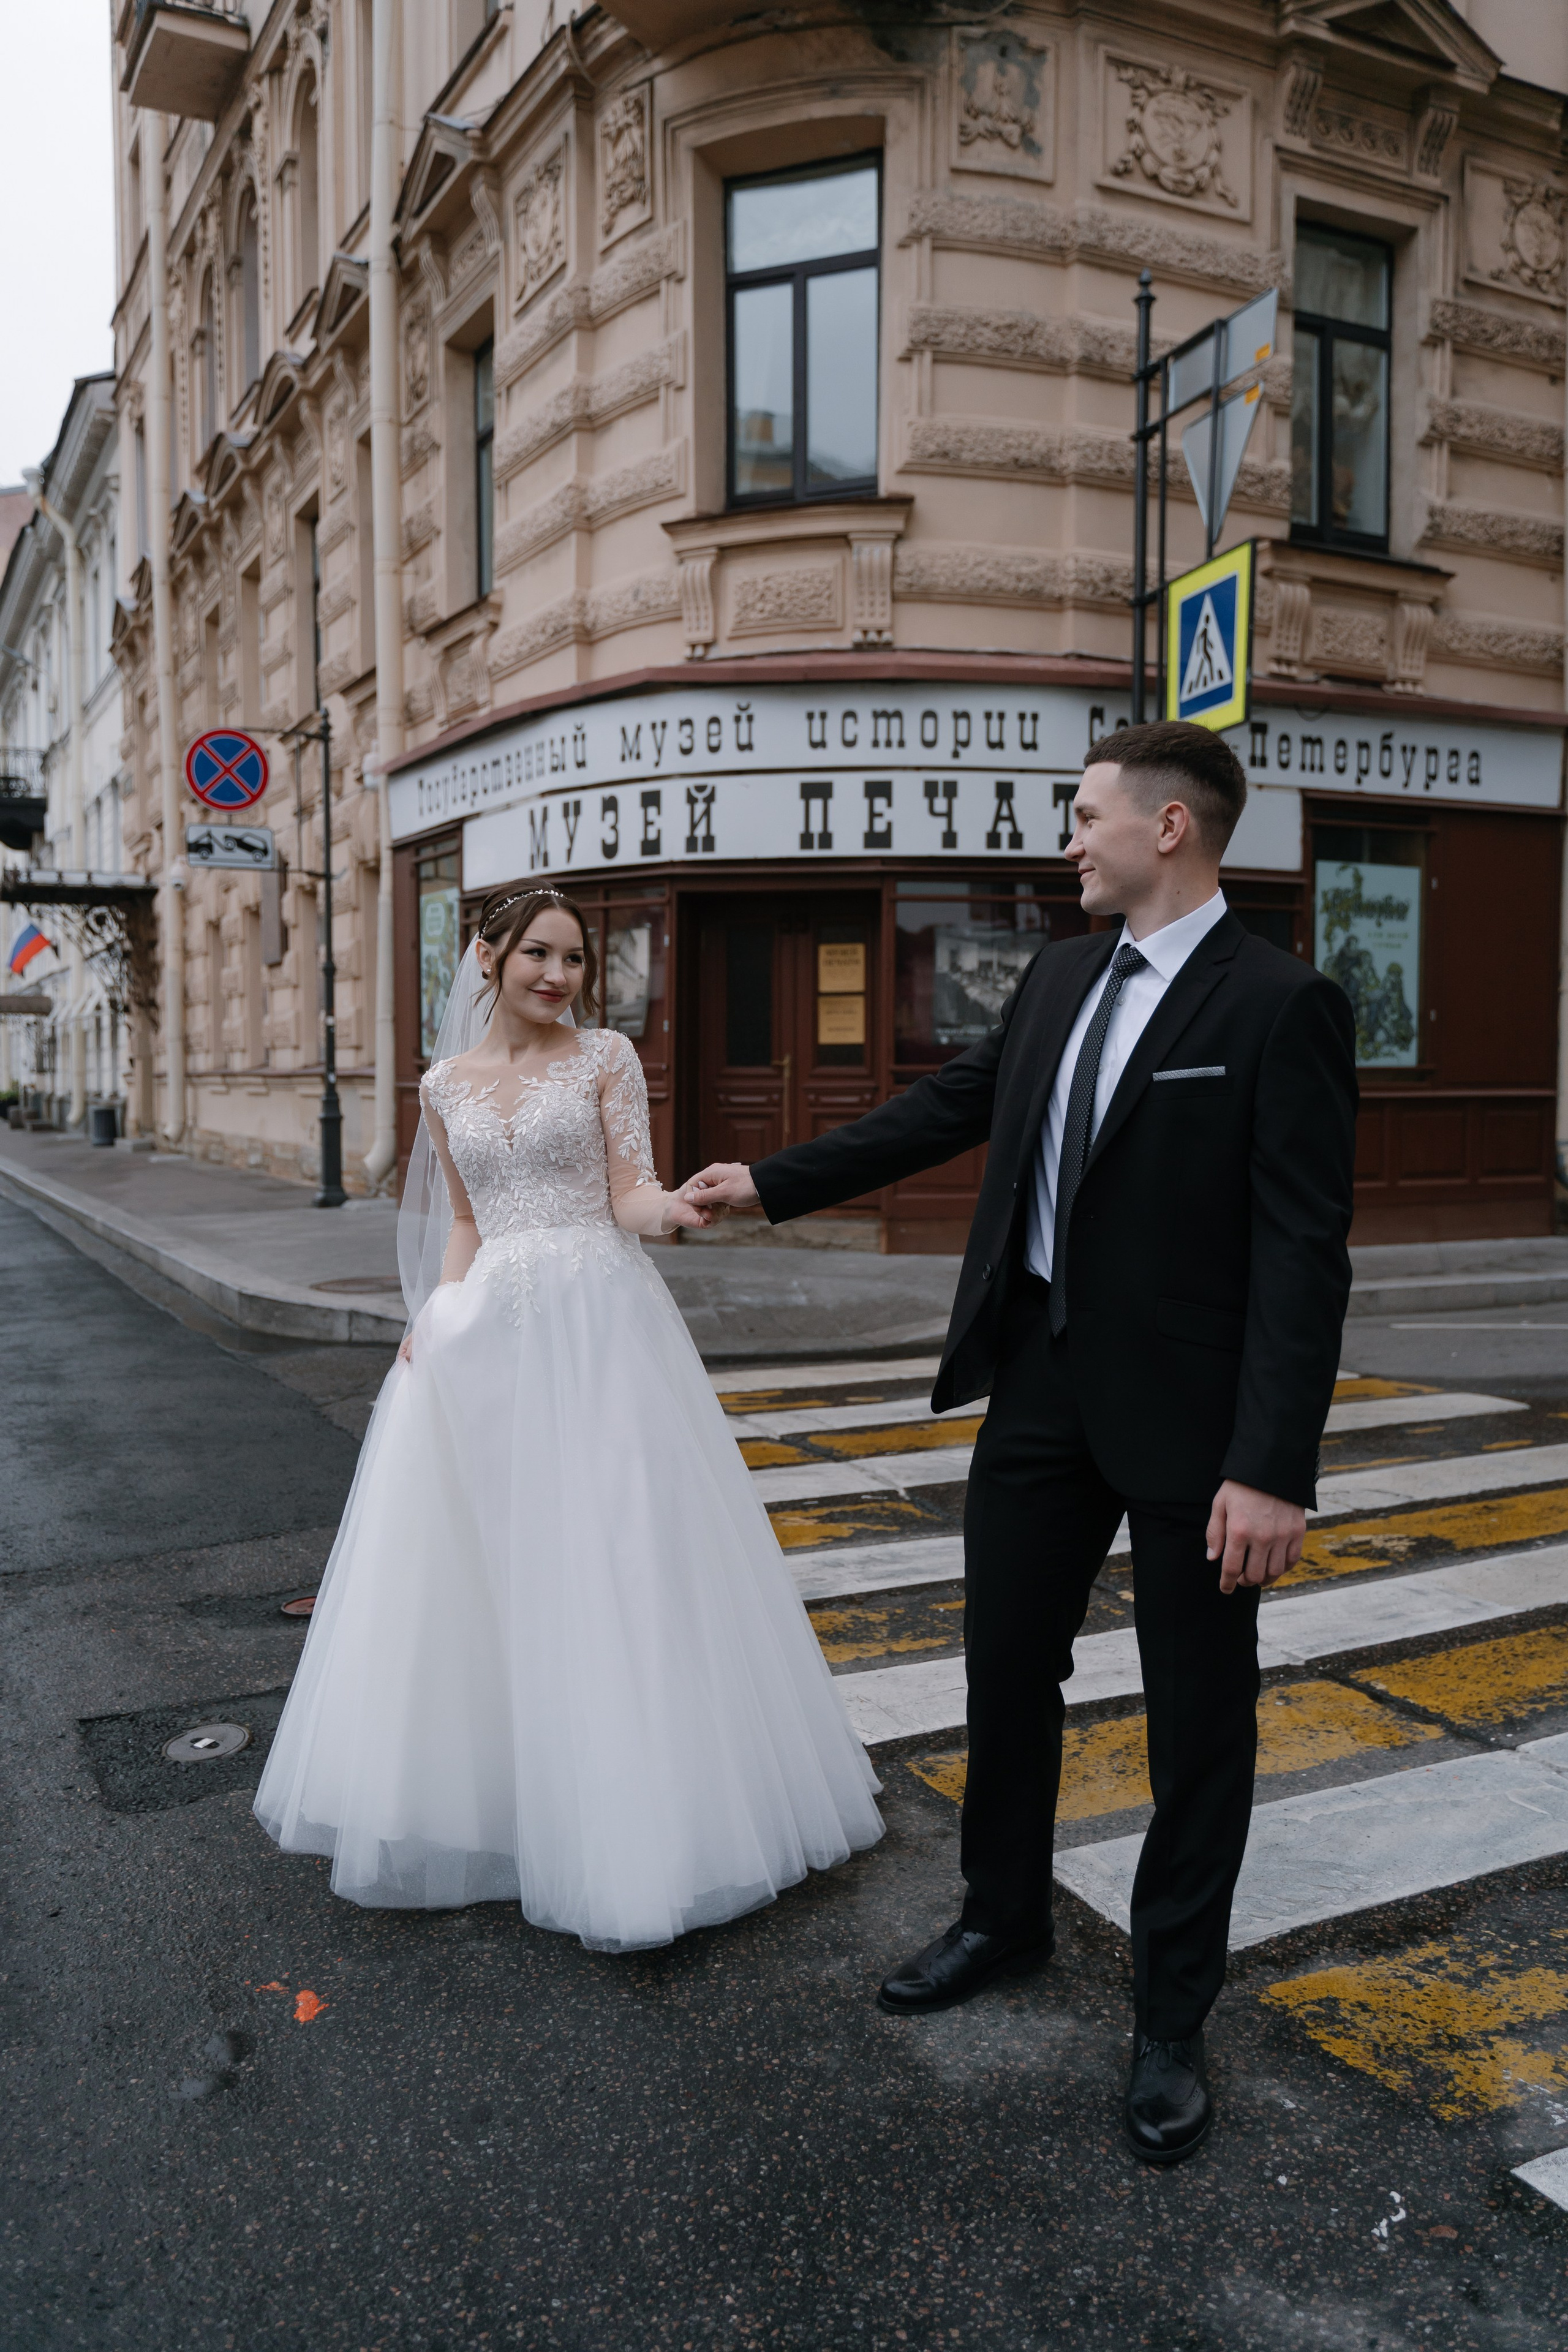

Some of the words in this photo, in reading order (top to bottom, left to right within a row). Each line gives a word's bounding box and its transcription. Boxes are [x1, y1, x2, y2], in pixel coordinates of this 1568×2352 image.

[418, 722, 586, 816] Государственный
[620, 702, 754, 767] музей
[806, 708, 1039, 759] истории
[530, 785, 715, 870] МУЗЕЙ
[800, 780, 1080, 850] ПЕЧАТ
